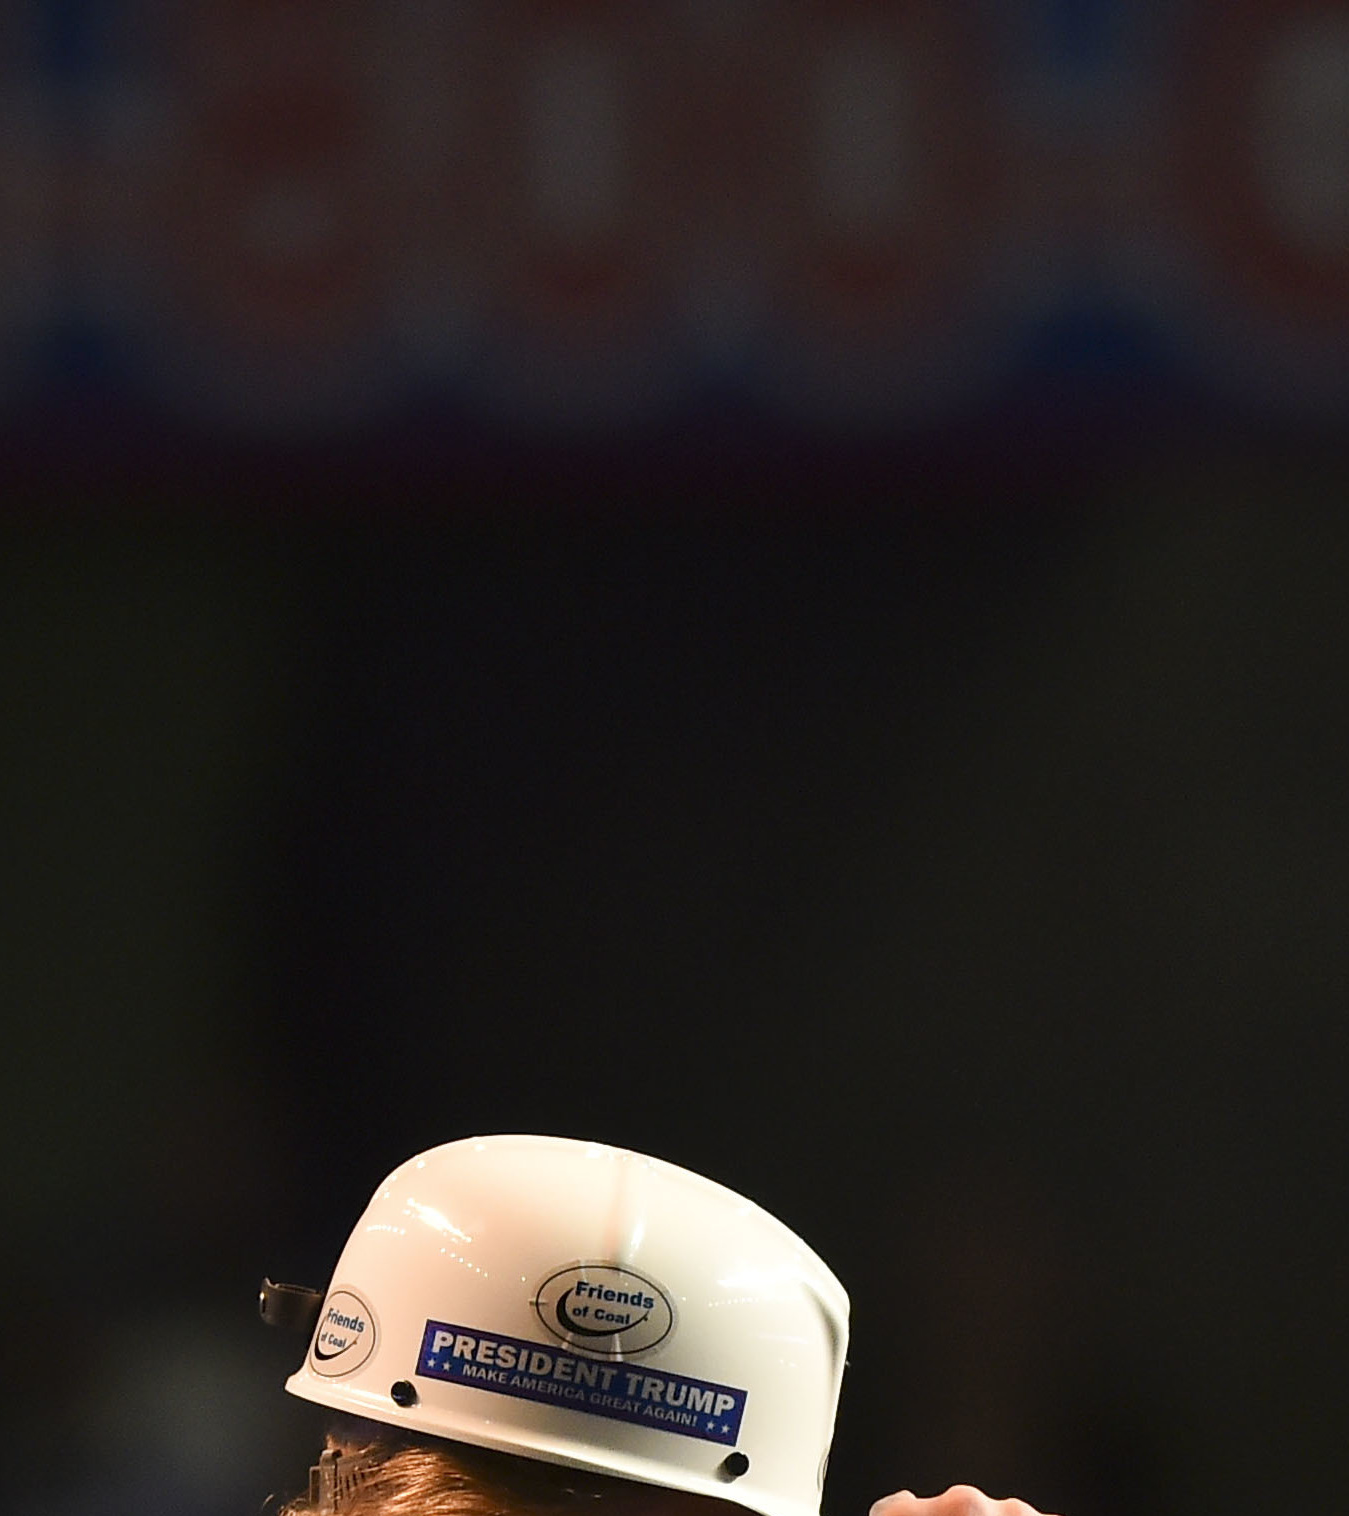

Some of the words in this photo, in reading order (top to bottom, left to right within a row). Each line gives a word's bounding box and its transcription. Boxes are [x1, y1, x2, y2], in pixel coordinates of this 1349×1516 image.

[575, 1281, 655, 1309] Friends
[326, 1307, 365, 1333] Friends
[572, 1306, 589, 1318] of
[594, 1308, 630, 1325] Coal
[328, 1333, 347, 1348] Coal
[431, 1330, 618, 1391] PRESIDENT
[626, 1373, 735, 1417] TRUMP
[462, 1364, 508, 1384] MAKE
[510, 1376, 585, 1401] AMERICA
[590, 1393, 642, 1413] GREAT
[643, 1404, 698, 1427] AGAIN!
